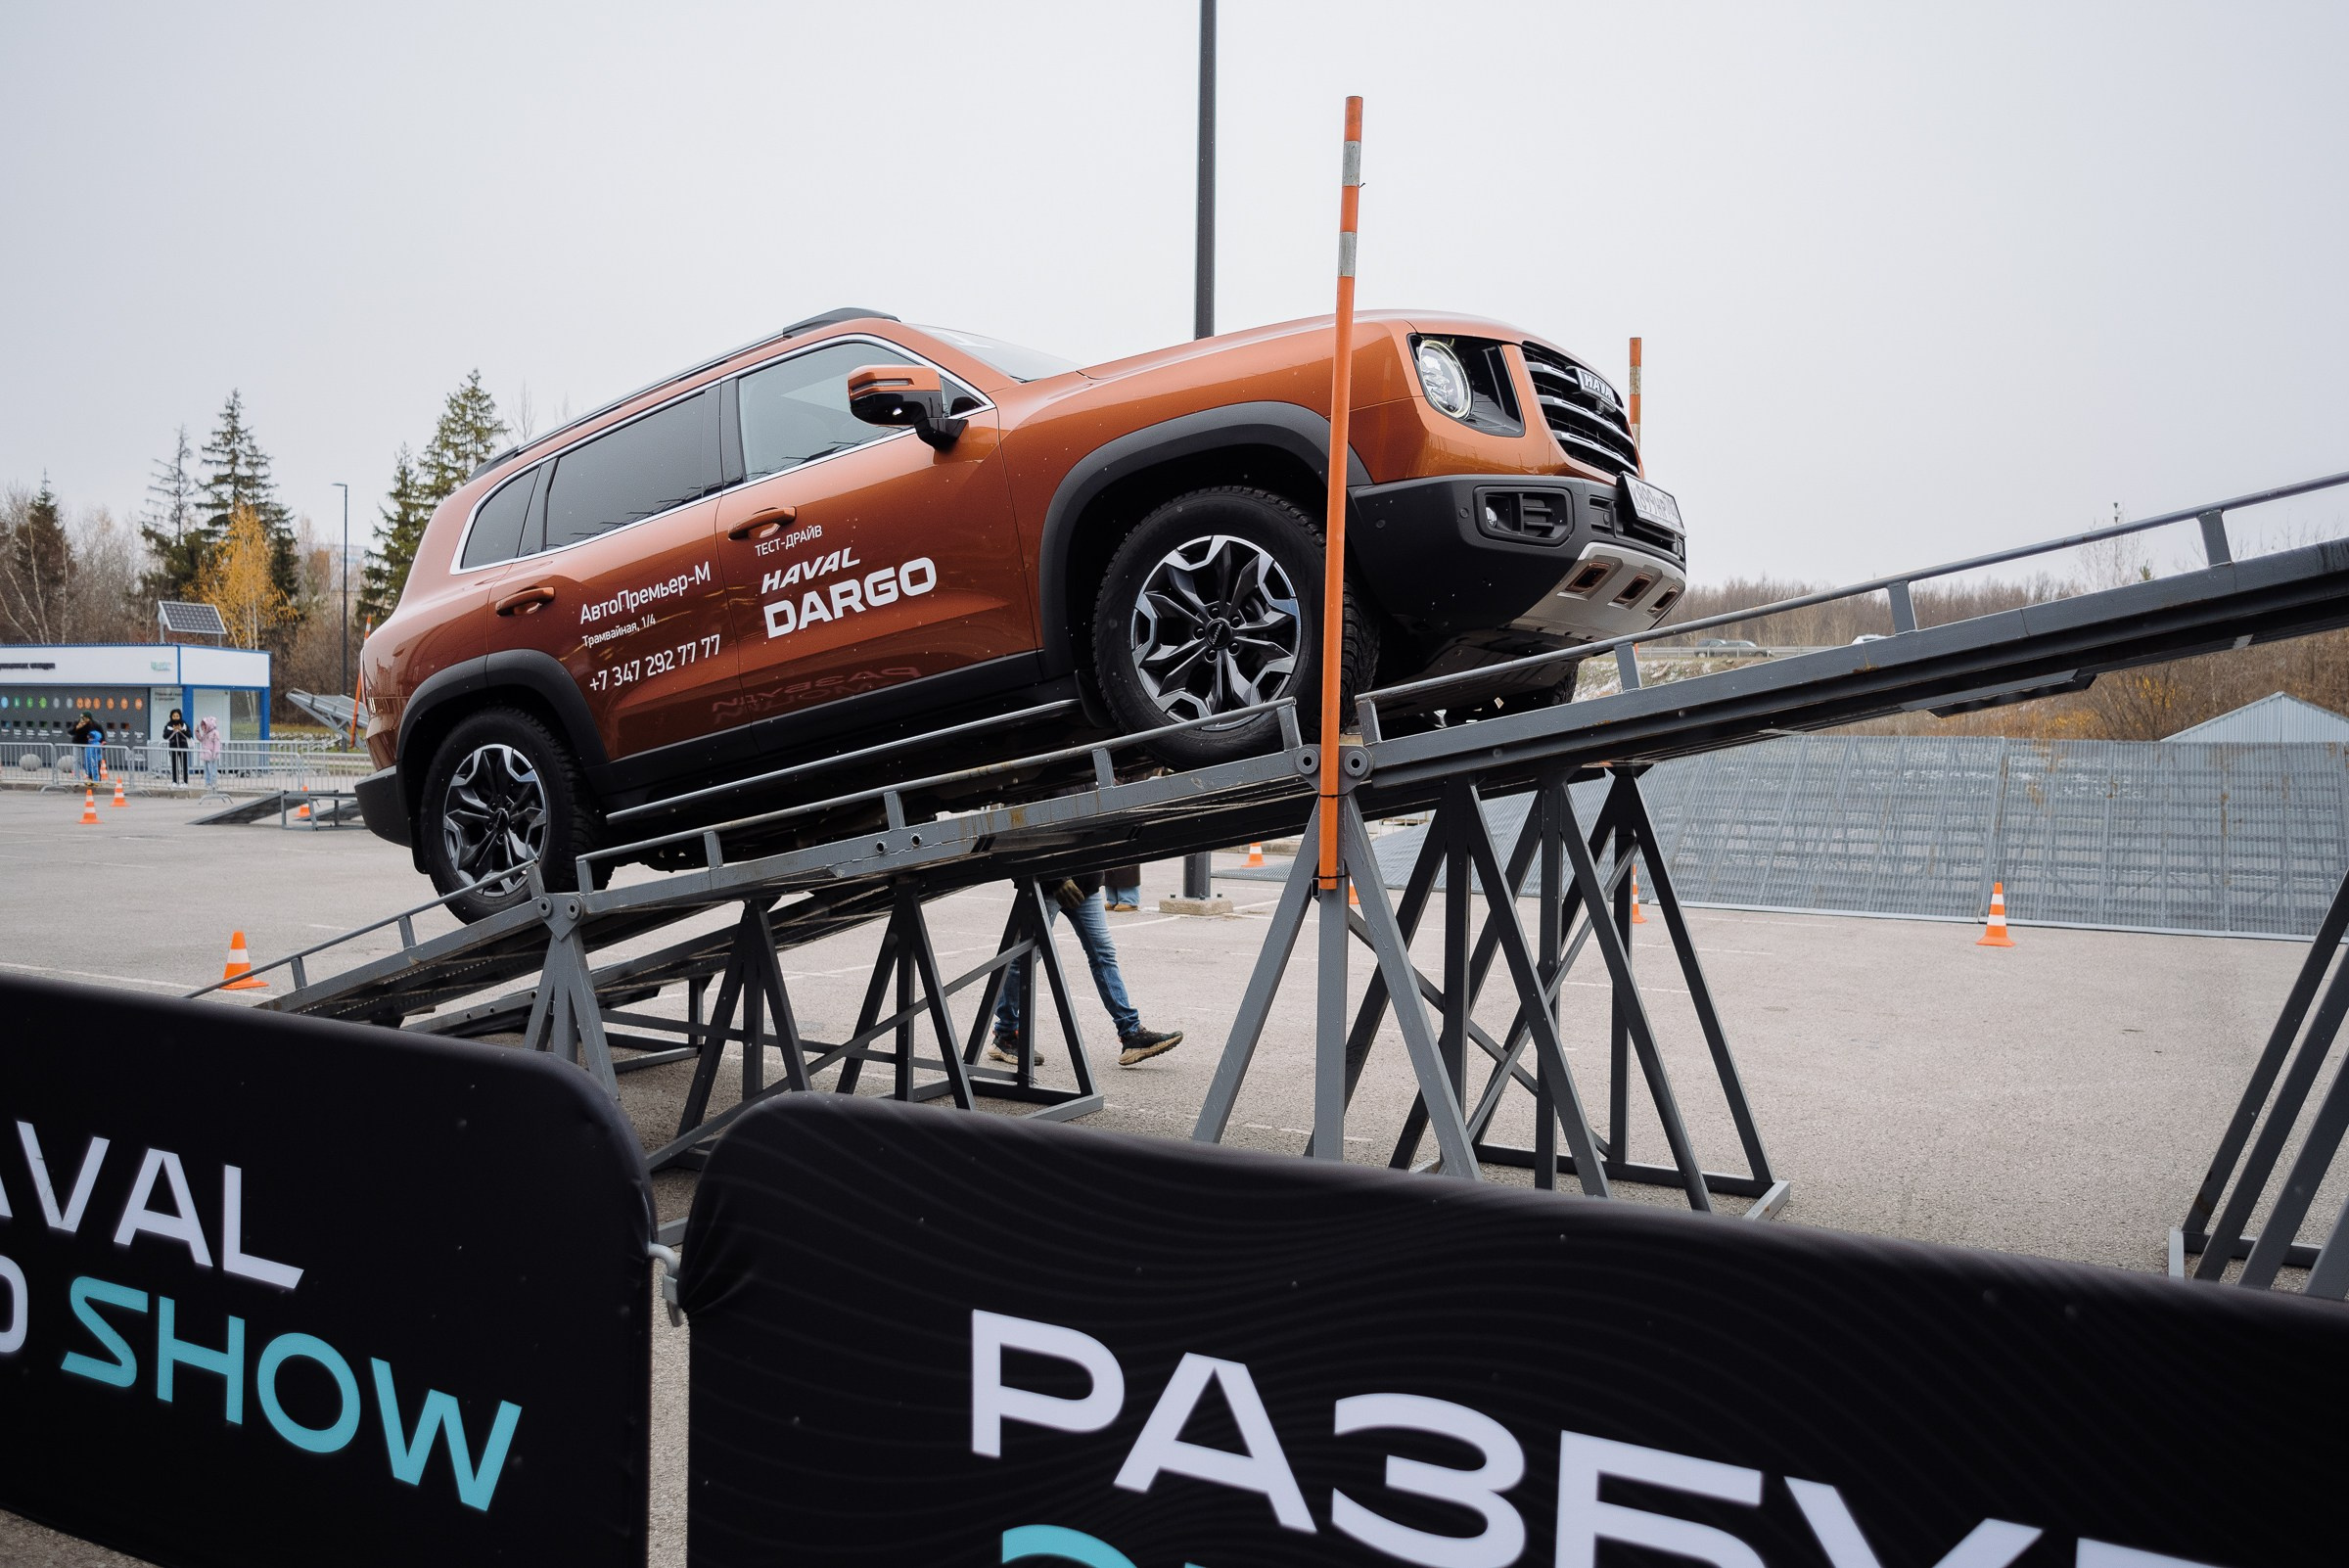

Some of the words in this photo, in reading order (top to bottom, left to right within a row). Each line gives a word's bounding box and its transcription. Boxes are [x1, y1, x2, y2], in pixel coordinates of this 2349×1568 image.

[755, 525, 823, 557] ТЕСТ-ДРАЙВ
[760, 546, 860, 595] HAVAL
[579, 561, 711, 624] АвтоПремьер-М
[763, 557, 938, 639] DARGO
[582, 622, 640, 648] Трамвайная,
[641, 614, 657, 629] 1/4
[589, 669, 608, 691] +7
[612, 659, 641, 686] 347
[645, 649, 675, 676] 292
[677, 641, 697, 666] 77
[701, 633, 720, 659] 77
[0, 1121, 304, 1290] VAL
[61, 1275, 523, 1512] SHOW
[972, 1309, 2232, 1568] РАЗБ
